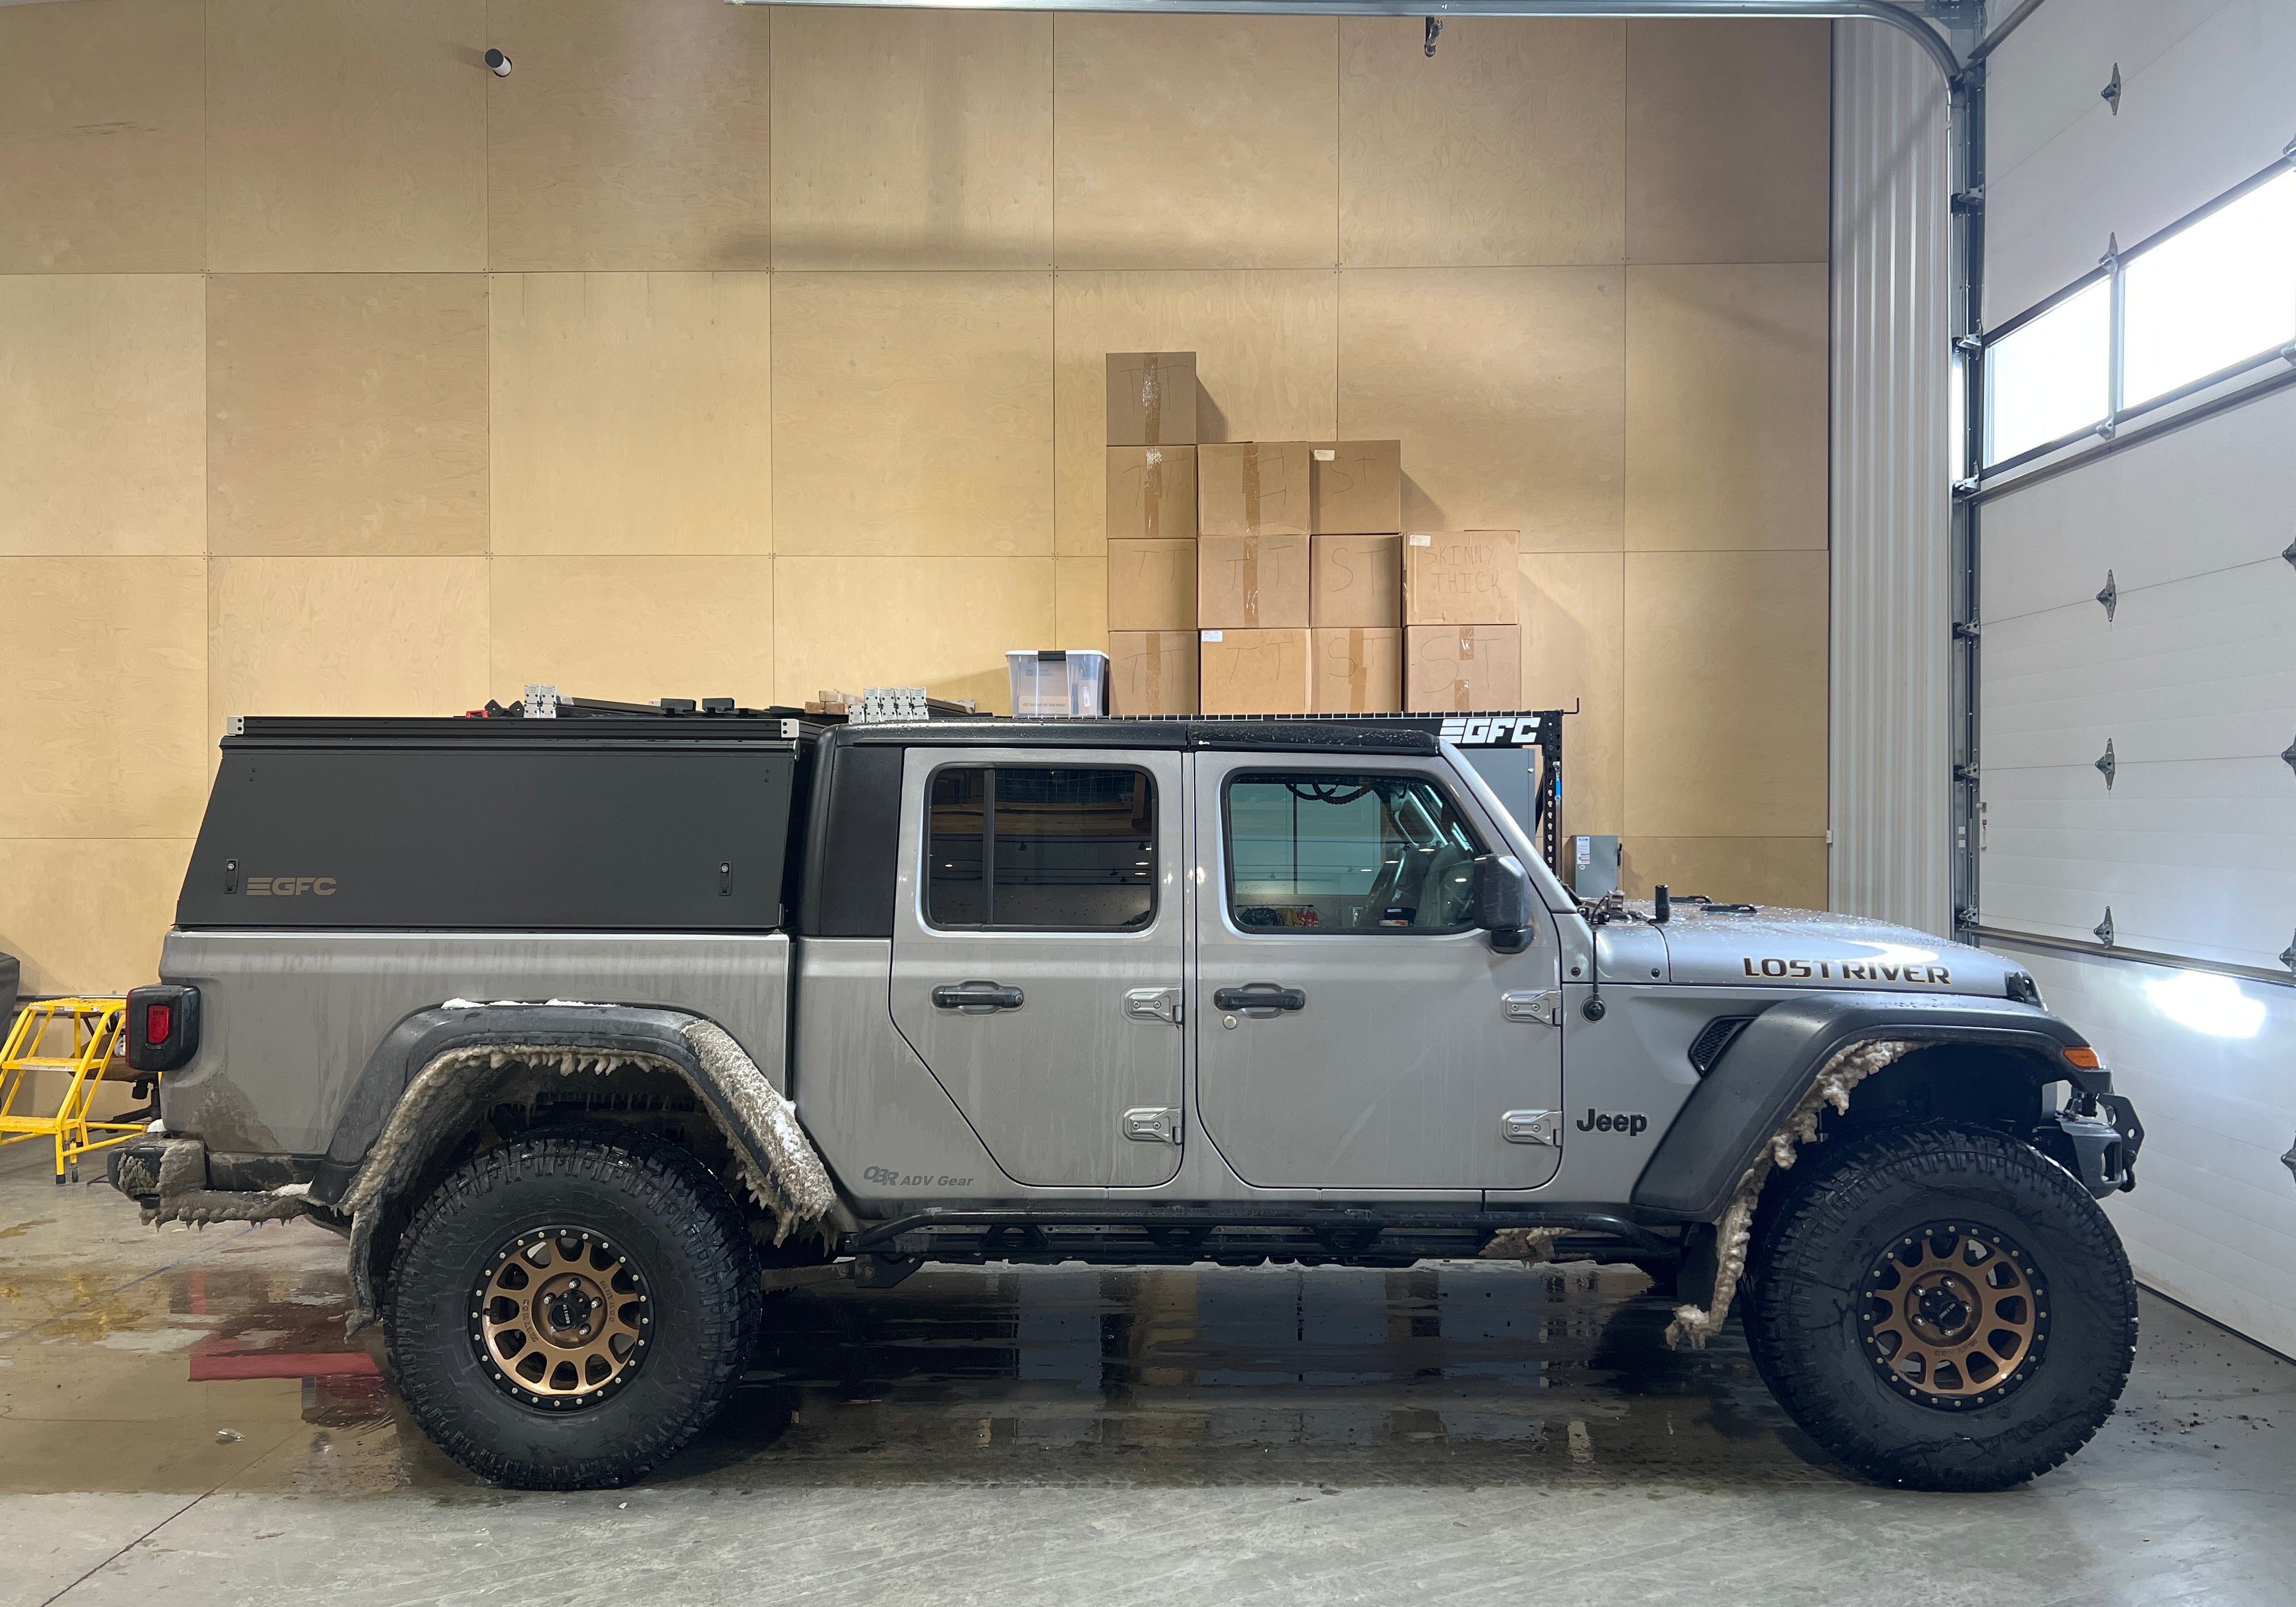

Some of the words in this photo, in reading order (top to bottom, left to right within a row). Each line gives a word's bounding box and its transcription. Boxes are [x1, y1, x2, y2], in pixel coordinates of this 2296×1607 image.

[1424, 544, 1495, 566] SKINNY
[1430, 570, 1502, 598] THICK
[1743, 957, 1835, 979] LOST
[1840, 960, 1952, 985] RIVER
[1576, 1108, 1647, 1137] Jeep
[900, 1175, 934, 1186] ADV
[937, 1175, 975, 1186] Gear
